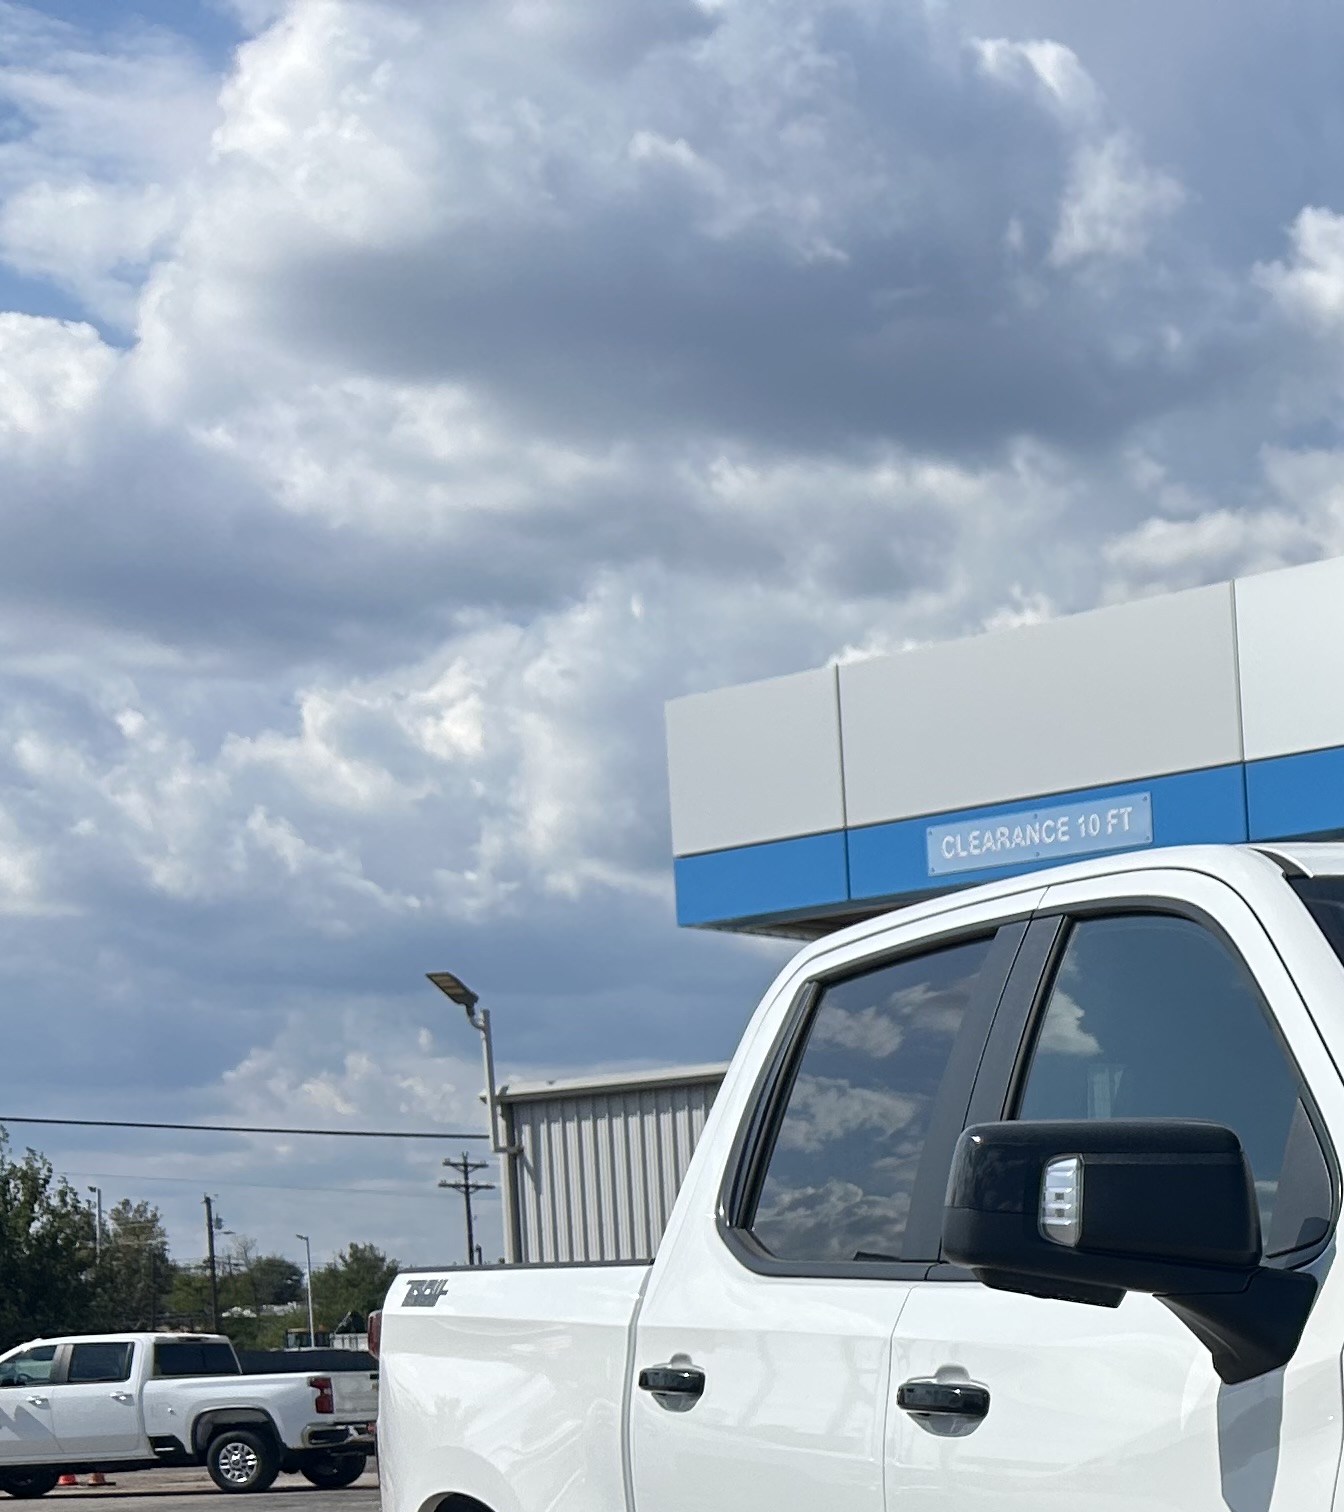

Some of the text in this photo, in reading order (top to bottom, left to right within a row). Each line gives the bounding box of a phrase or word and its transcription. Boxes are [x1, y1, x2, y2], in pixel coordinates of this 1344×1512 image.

[941, 806, 1133, 858] CLEARANCE 10 FT
